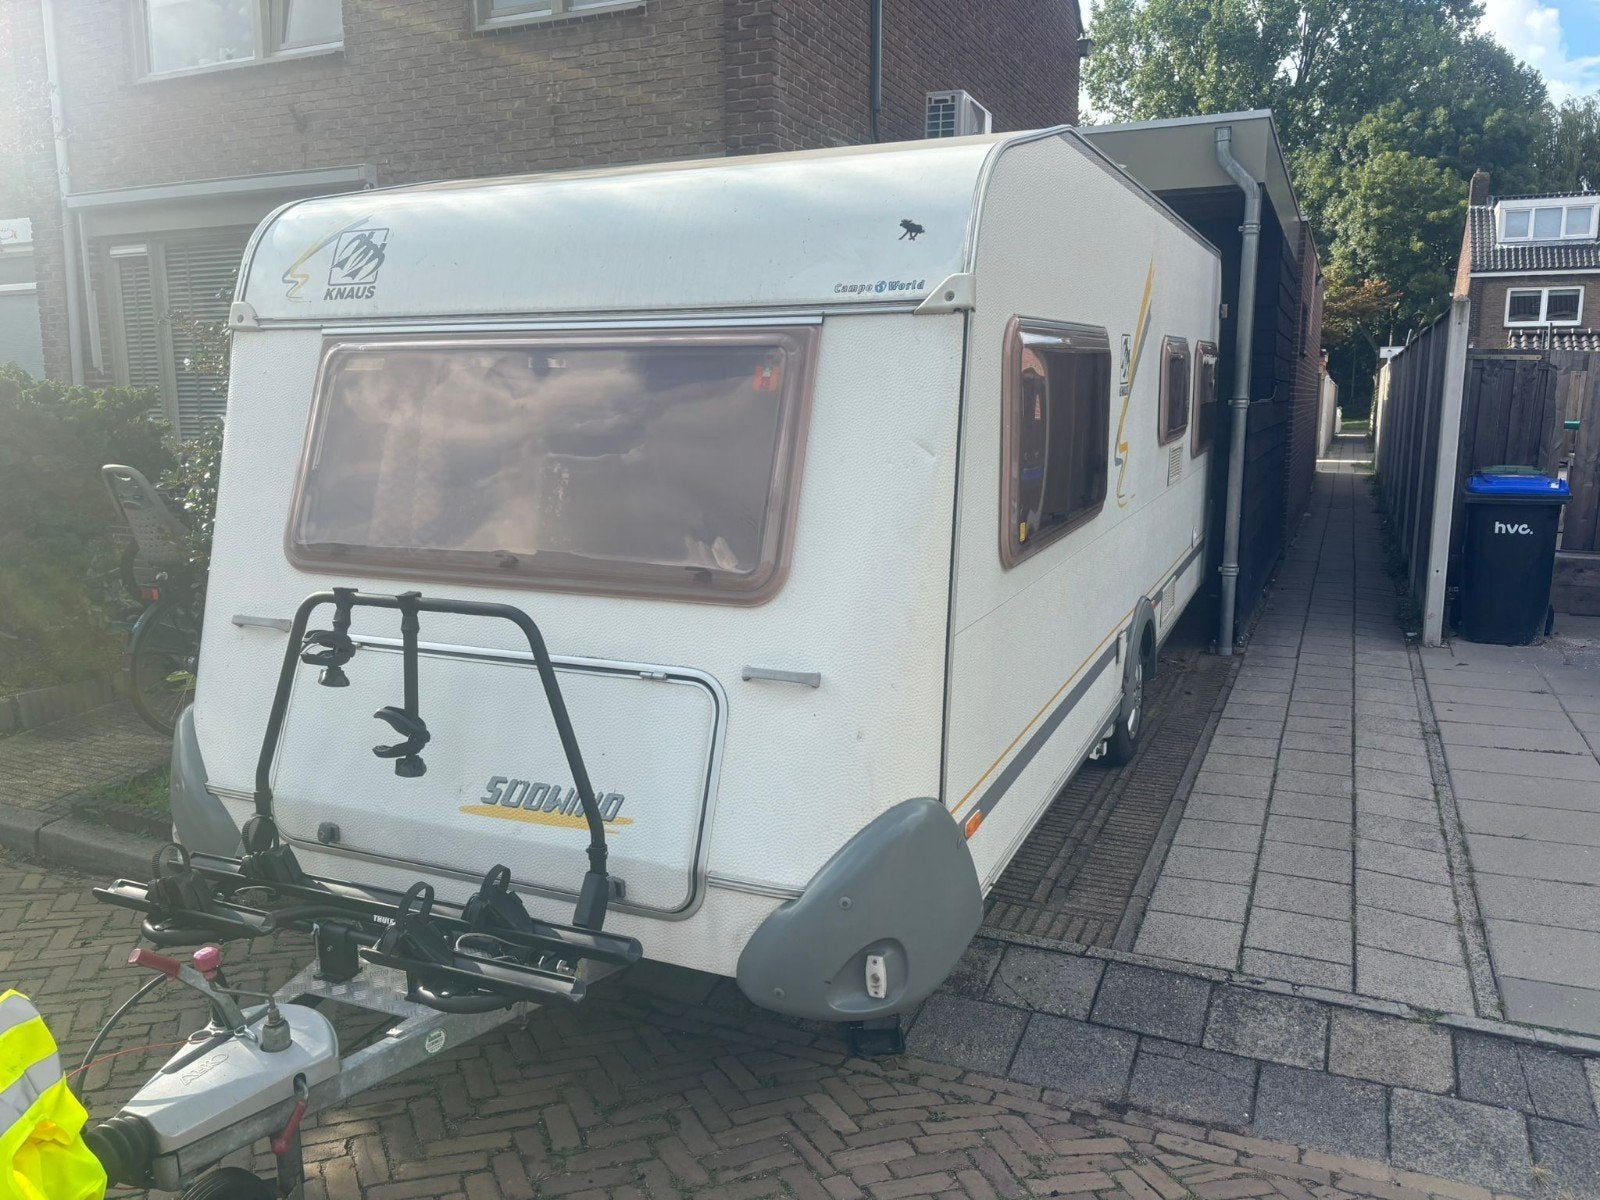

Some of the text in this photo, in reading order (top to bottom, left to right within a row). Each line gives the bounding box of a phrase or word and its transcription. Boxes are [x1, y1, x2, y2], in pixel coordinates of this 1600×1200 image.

[888, 279, 925, 291] World
[324, 285, 376, 300] KNAUS
[1494, 521, 1534, 535] hvc.
